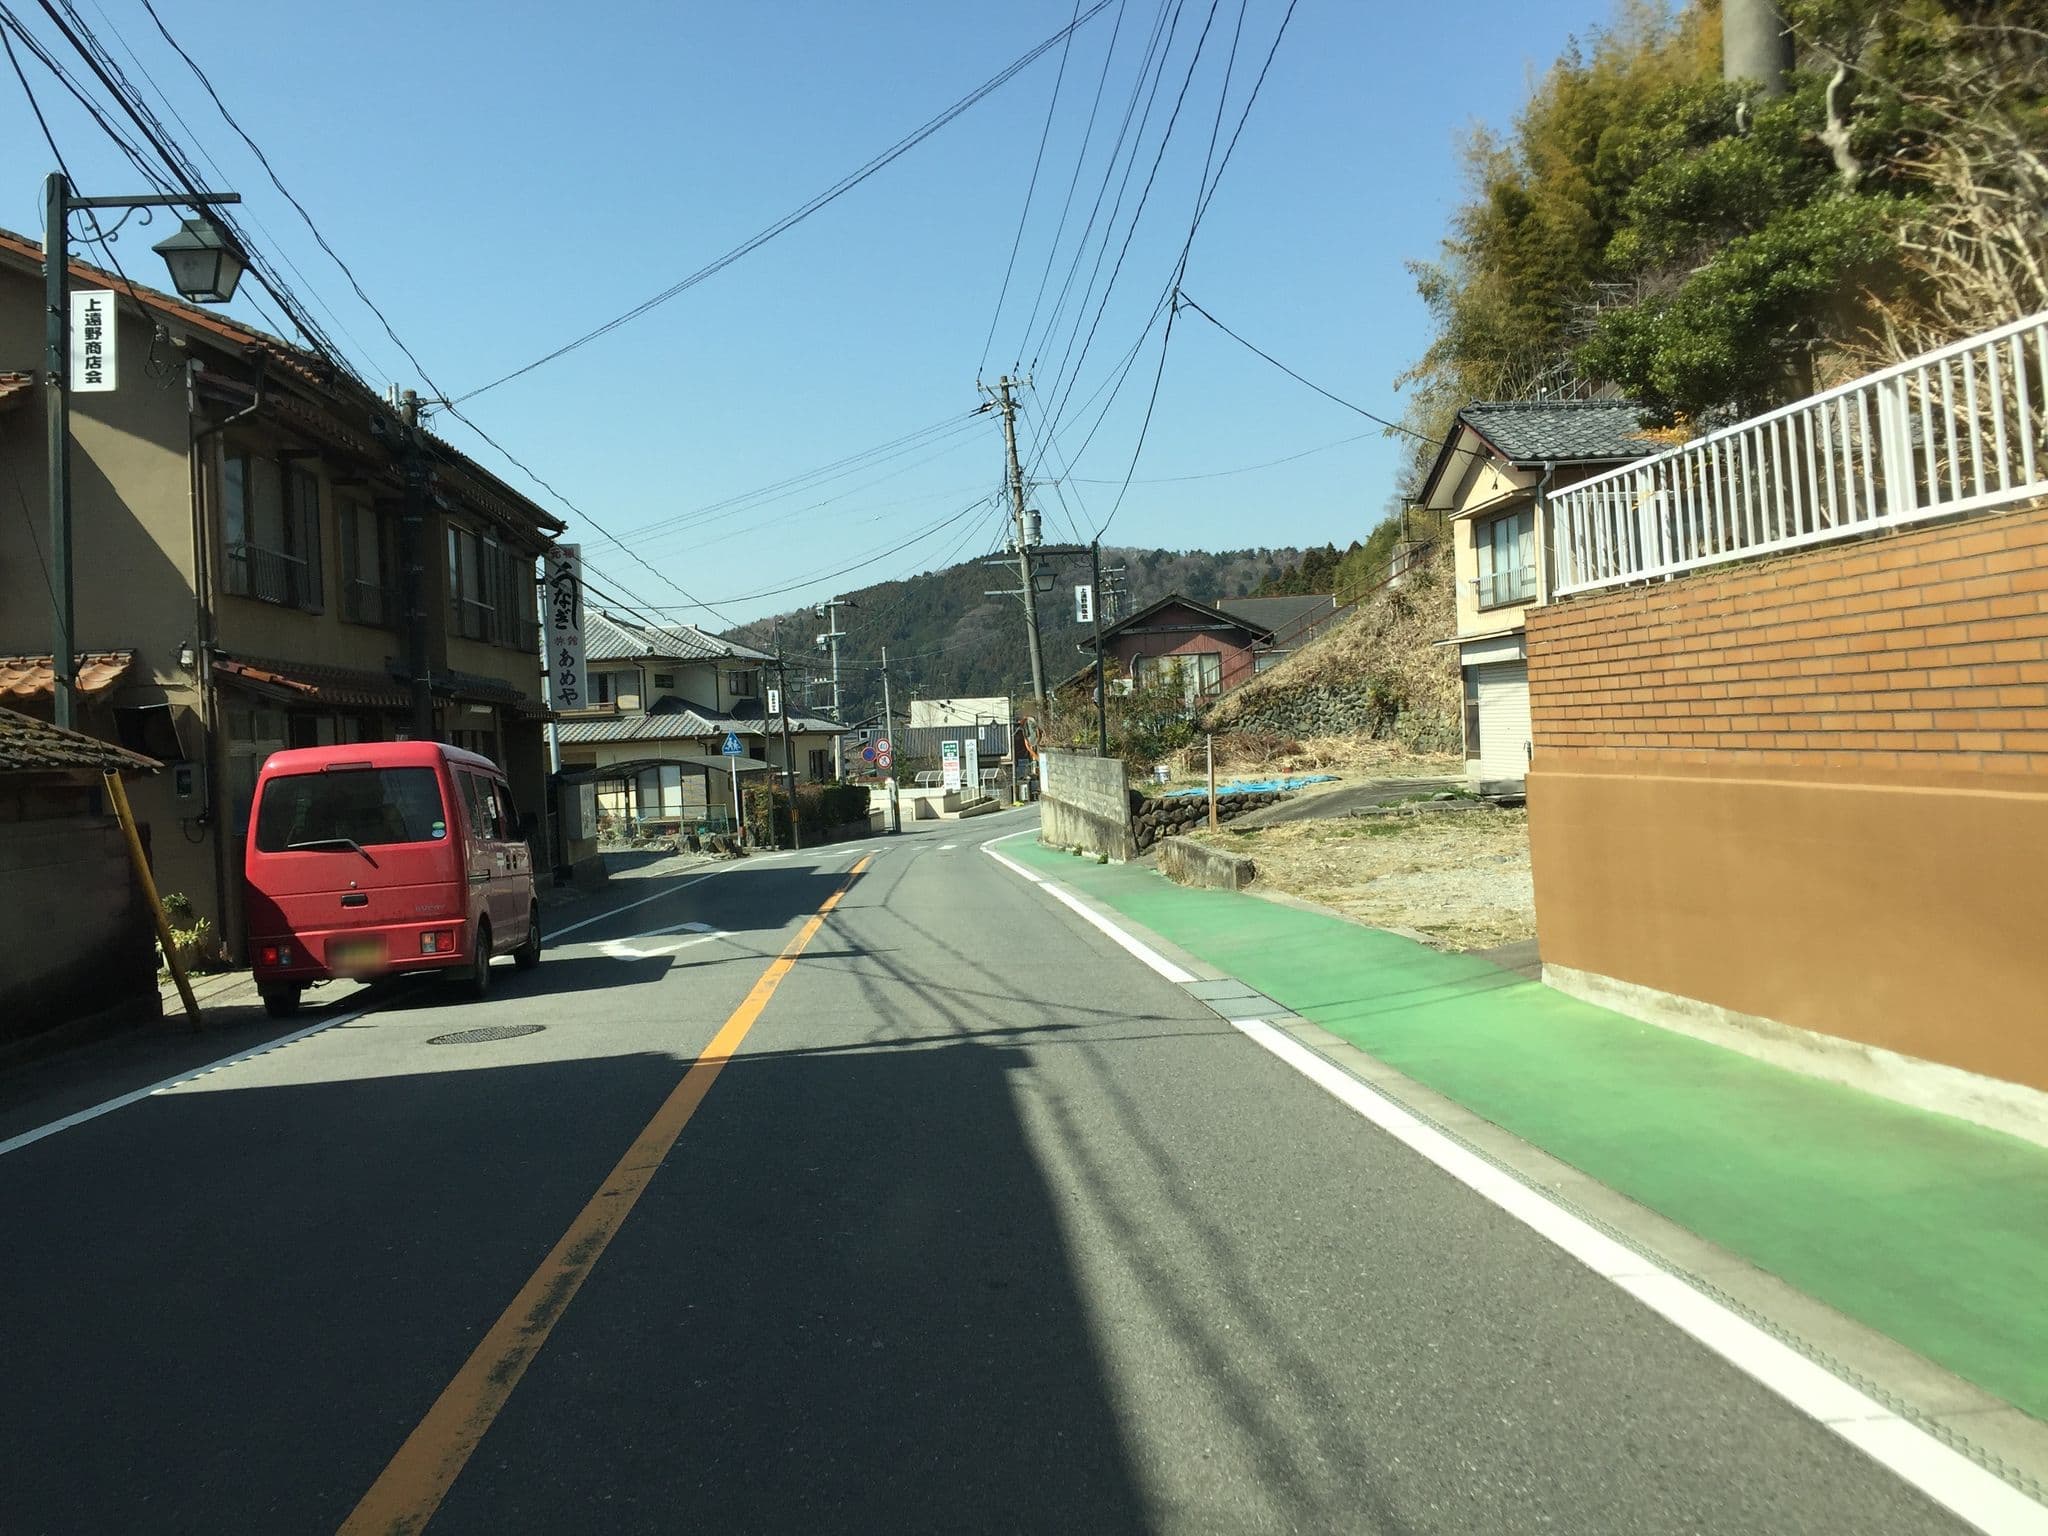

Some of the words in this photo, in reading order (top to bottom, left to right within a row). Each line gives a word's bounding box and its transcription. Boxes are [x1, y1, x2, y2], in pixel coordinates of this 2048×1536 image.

[84, 298, 102, 384] 上遠野商店会
[550, 561, 578, 630] うなぎ
[558, 648, 578, 705] あめや
